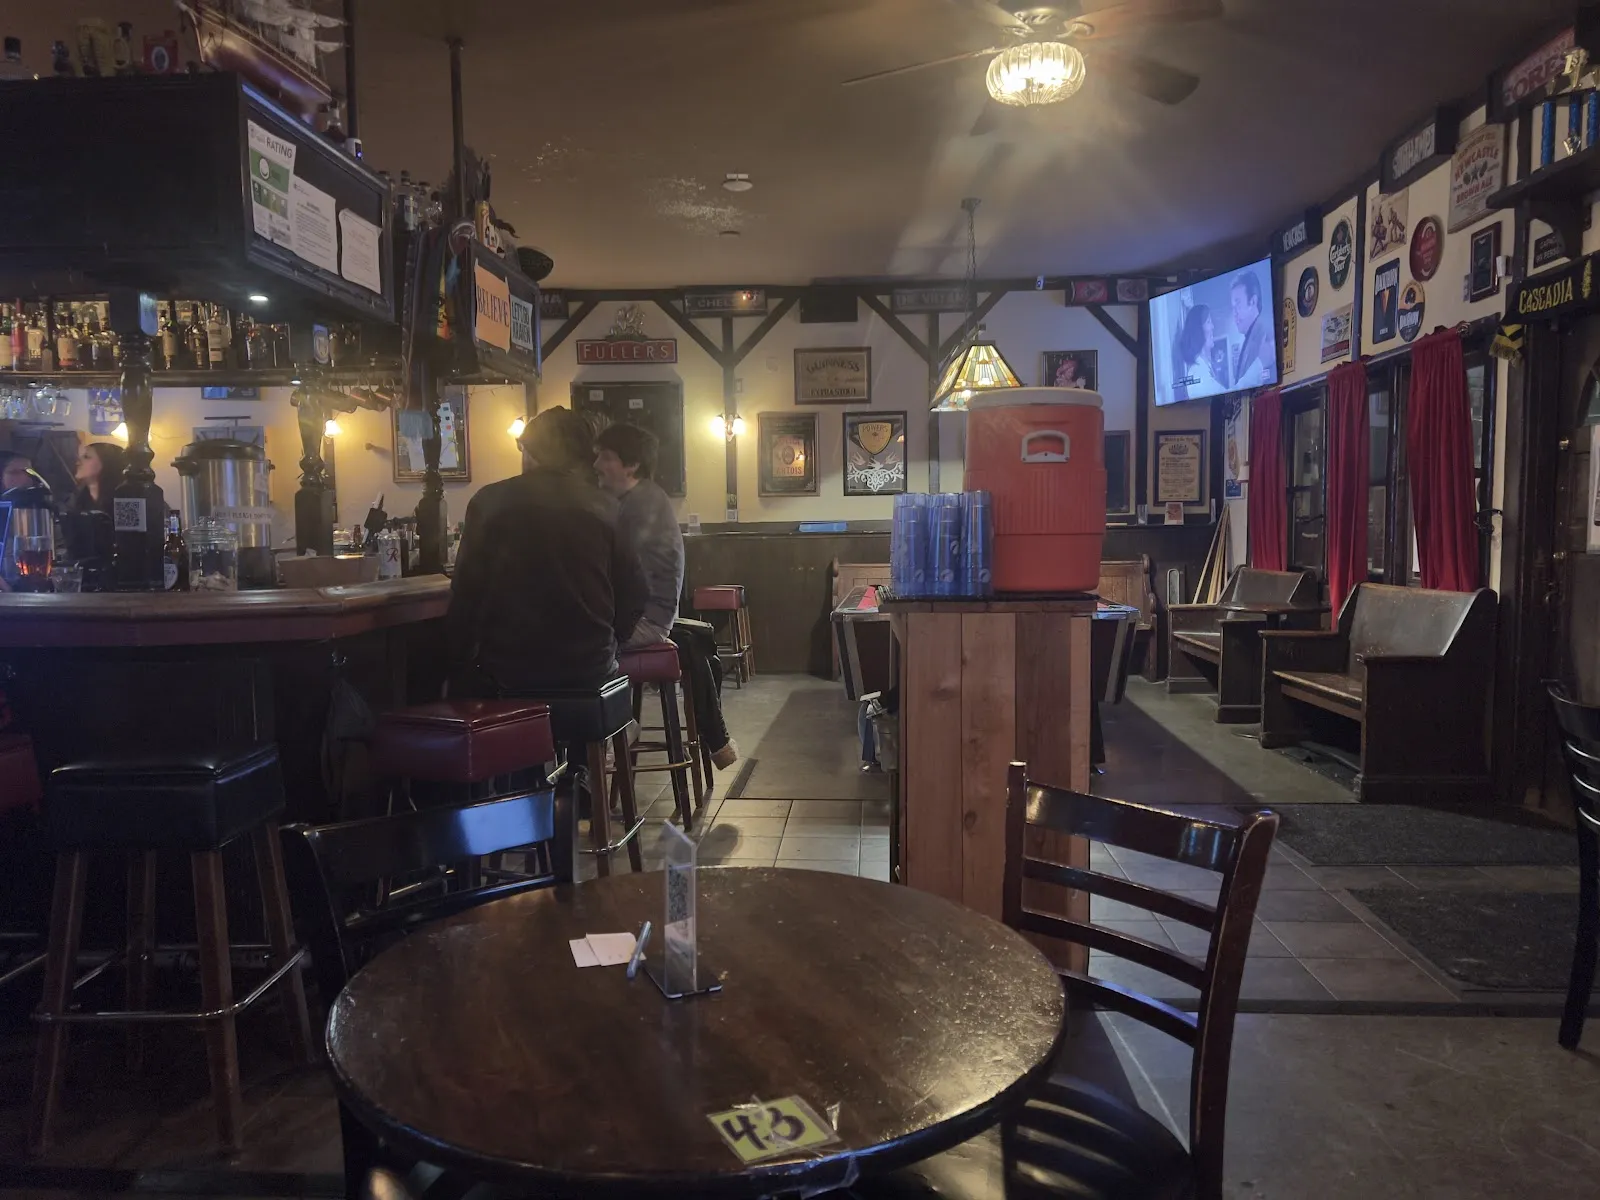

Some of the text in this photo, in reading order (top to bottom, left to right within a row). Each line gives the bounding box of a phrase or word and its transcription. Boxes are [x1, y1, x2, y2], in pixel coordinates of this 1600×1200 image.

[266, 138, 293, 159] RATING
[1455, 146, 1500, 182] NEWCASTLE
[1456, 183, 1480, 203] BROWN
[1481, 176, 1493, 189] ALE
[1329, 242, 1352, 263] Carlsberg
[1334, 260, 1346, 273] Beer
[1519, 276, 1573, 314] CASCADIA
[477, 285, 509, 328] BELIEVE
[583, 344, 669, 359] FULLERS
[805, 357, 860, 375] GUINNESS
[862, 424, 889, 433] POWERS
[776, 466, 802, 475] ARTOIS
[721, 1107, 806, 1151] 43
